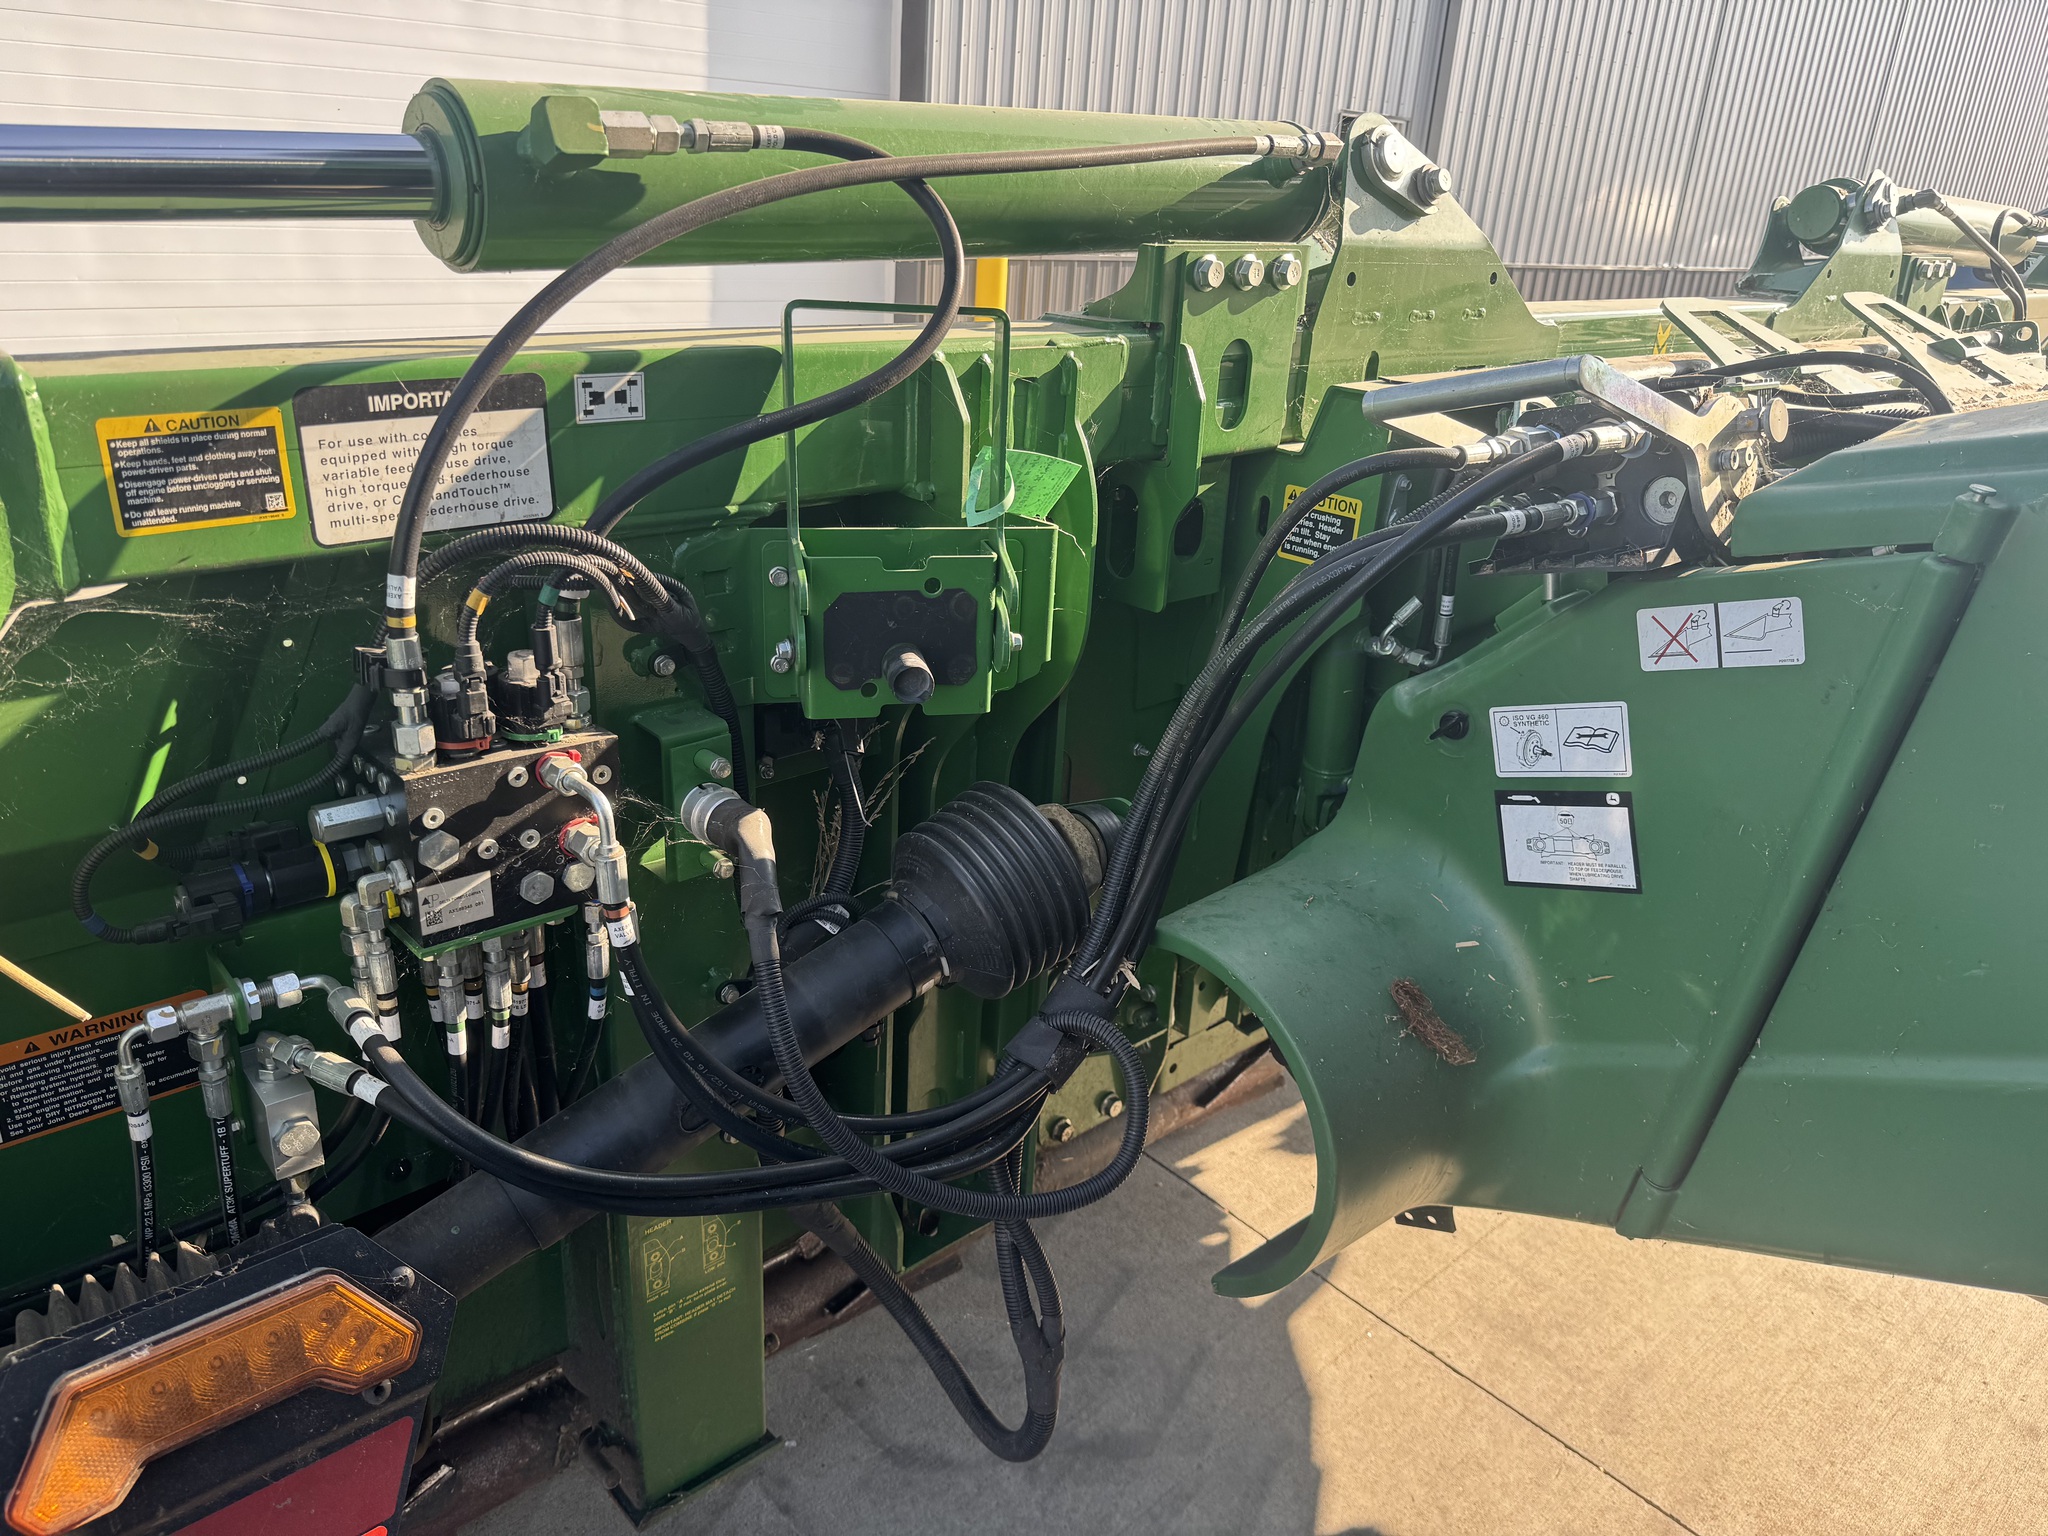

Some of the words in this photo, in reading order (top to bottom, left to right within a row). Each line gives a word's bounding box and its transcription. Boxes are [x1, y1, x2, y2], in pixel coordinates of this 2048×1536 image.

[368, 390, 451, 412] IMPORTA
[166, 415, 239, 431] CAUTION
[116, 440, 137, 448] Keep
[139, 438, 149, 446] all
[150, 436, 180, 445] shields
[191, 434, 212, 443] place
[214, 432, 239, 440] during
[241, 428, 267, 438] normal
[319, 439, 342, 449] For
[348, 437, 372, 447] use
[379, 433, 407, 444] with
[118, 448, 164, 458] operations.
[120, 460, 141, 468] Keep
[143, 458, 170, 466] hands,
[171, 456, 187, 464] feet
[188, 454, 203, 462] and
[205, 452, 236, 460] clothing
[237, 450, 256, 458] away
[258, 448, 275, 456] from
[321, 450, 386, 467] equipped
[392, 447, 420, 458] with
[472, 440, 513, 451] torque
[122, 466, 174, 478] power-driven
[176, 464, 199, 473] parts.
[323, 467, 380, 481] variable
[474, 455, 510, 466] drive,
[1336, 470, 1359, 484] MSHA
[124, 478, 166, 489] Disengage
[168, 473, 217, 485] power-driven
[219, 470, 238, 480] parts
[240, 469, 254, 477] and
[256, 467, 272, 475] shut
[126, 489, 136, 497] off
[138, 487, 166, 496] engine
[166, 484, 192, 493] before
[193, 480, 236, 491] unclogging
[246, 475, 280, 485] servicing
[325, 485, 356, 498] high
[362, 481, 407, 493] torque
[451, 468, 530, 483] feederhouse
[128, 496, 164, 505] machine.
[130, 511, 142, 519] Do
[143, 509, 156, 517] not
[157, 507, 177, 516] leave
[179, 504, 208, 513] running
[210, 500, 241, 510] machine
[328, 501, 368, 513] drive,
[374, 499, 387, 508] or
[504, 496, 539, 507] drive.
[132, 515, 177, 527] unattended.
[1310, 512, 1341, 526] crushing
[1318, 522, 1344, 535] Header
[1301, 527, 1311, 536] tilt.
[1315, 531, 1331, 542] Stay
[1304, 538, 1322, 548] when
[1292, 545, 1320, 558] running.
[1226, 621, 1269, 668] ALFAGOMMA
[1274, 593, 1298, 615] ITALY
[1171, 752, 1182, 768] TYPE
[624, 959, 640, 988] ITALY
[640, 994, 652, 1006] IN
[651, 1011, 671, 1034] MADE
[671, 1037, 683, 1048] 20
[0, 1064, 16, 1073] void
[20, 1057, 47, 1067] serious
[50, 1049, 71, 1059] injury
[75, 1043, 92, 1051] from
[95, 1034, 121, 1046] contact
[10, 1070, 24, 1078] and
[44, 1059, 65, 1068] under
[69, 1048, 102, 1061] pressure.
[10, 1089, 37, 1100] Relieve
[41, 1080, 66, 1091] system
[70, 1069, 102, 1082] hydraulic
[146, 1049, 165, 1058] Refer
[12, 1079, 46, 1092] changing
[49, 1063, 98, 1080] accumulators:
[26, 1068, 60, 1081] removing
[64, 1057, 96, 1070] hydraulic
[15, 1111, 32, 1120] Stop
[36, 1103, 60, 1114] engine
[80, 1089, 106, 1100] remove
[159, 1066, 199, 1082] accumulator
[23, 1091, 54, 1103] Operator
[58, 1082, 84, 1092] Manual
[88, 1076, 101, 1084] and
[14, 1102, 40, 1114] system
[43, 1088, 85, 1104] information.
[8, 1122, 23, 1130] Use
[26, 1116, 41, 1124] only
[46, 1109, 60, 1118] DRY
[64, 1097, 103, 1112] NITROGEN
[27, 1122, 44, 1132] your
[48, 1116, 65, 1125] John
[69, 1108, 89, 1118] Deere
[93, 1100, 116, 1110] dealer.
[218, 1126, 226, 1138] 1B
[220, 1145, 234, 1195] SUPERTUFF
[144, 1192, 153, 1210] MPa
[227, 1195, 237, 1214] AT3K
[144, 1211, 154, 1228] 22.5
[644, 1218, 672, 1235] HEADER
[684, 1303, 705, 1316] HEADER
[717, 1287, 736, 1300] DETACH
[655, 1326, 670, 1337] FROM
